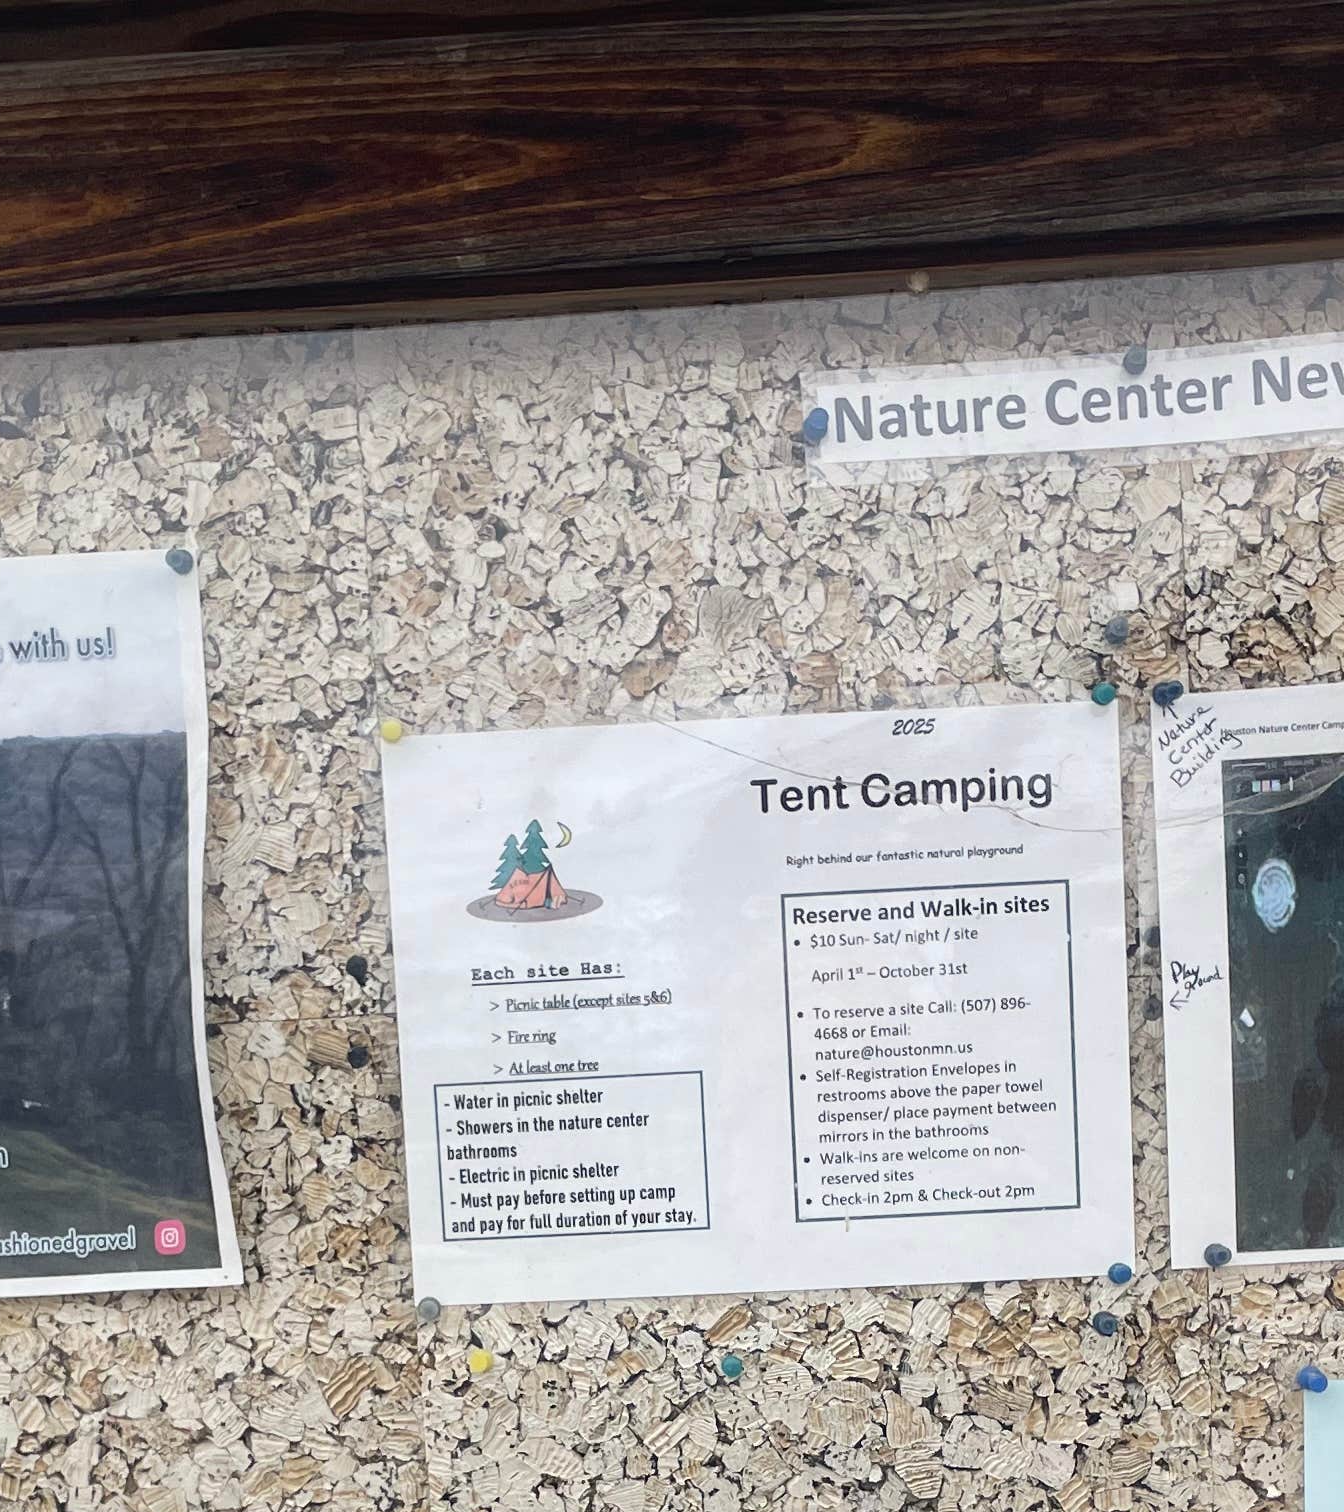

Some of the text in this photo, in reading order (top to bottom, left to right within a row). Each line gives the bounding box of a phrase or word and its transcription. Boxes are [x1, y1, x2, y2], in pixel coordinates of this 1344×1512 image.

[834, 393, 1027, 443] Nature
[1044, 373, 1233, 426] Center
[9, 627, 67, 660] with
[76, 626, 116, 658] us!
[891, 718, 936, 737] 2025
[1158, 704, 1213, 750] Nature
[1257, 724, 1290, 735] Nature
[1290, 722, 1321, 733] Center
[1170, 731, 1243, 788] Building
[749, 767, 1055, 814] Tent Camping
[785, 843, 1024, 870] Right behind our fantastic natural playground
[792, 895, 1050, 926] Reserve and Walk-in sites
[809, 933, 836, 950] $10
[904, 928, 941, 946] night
[953, 927, 979, 941] site
[471, 962, 622, 981] Each site Has:
[811, 967, 844, 985] April
[878, 963, 936, 979] October
[938, 962, 969, 976] 31st
[811, 996, 1032, 1020] To reserve a site Call: (507) 896-
[508, 1030, 557, 1045] Fire ring
[813, 1022, 912, 1041] 4668 or Email:
[815, 1043, 974, 1062] nature@houstonmn.us
[454, 1087, 604, 1112] Water in picnic shelter
